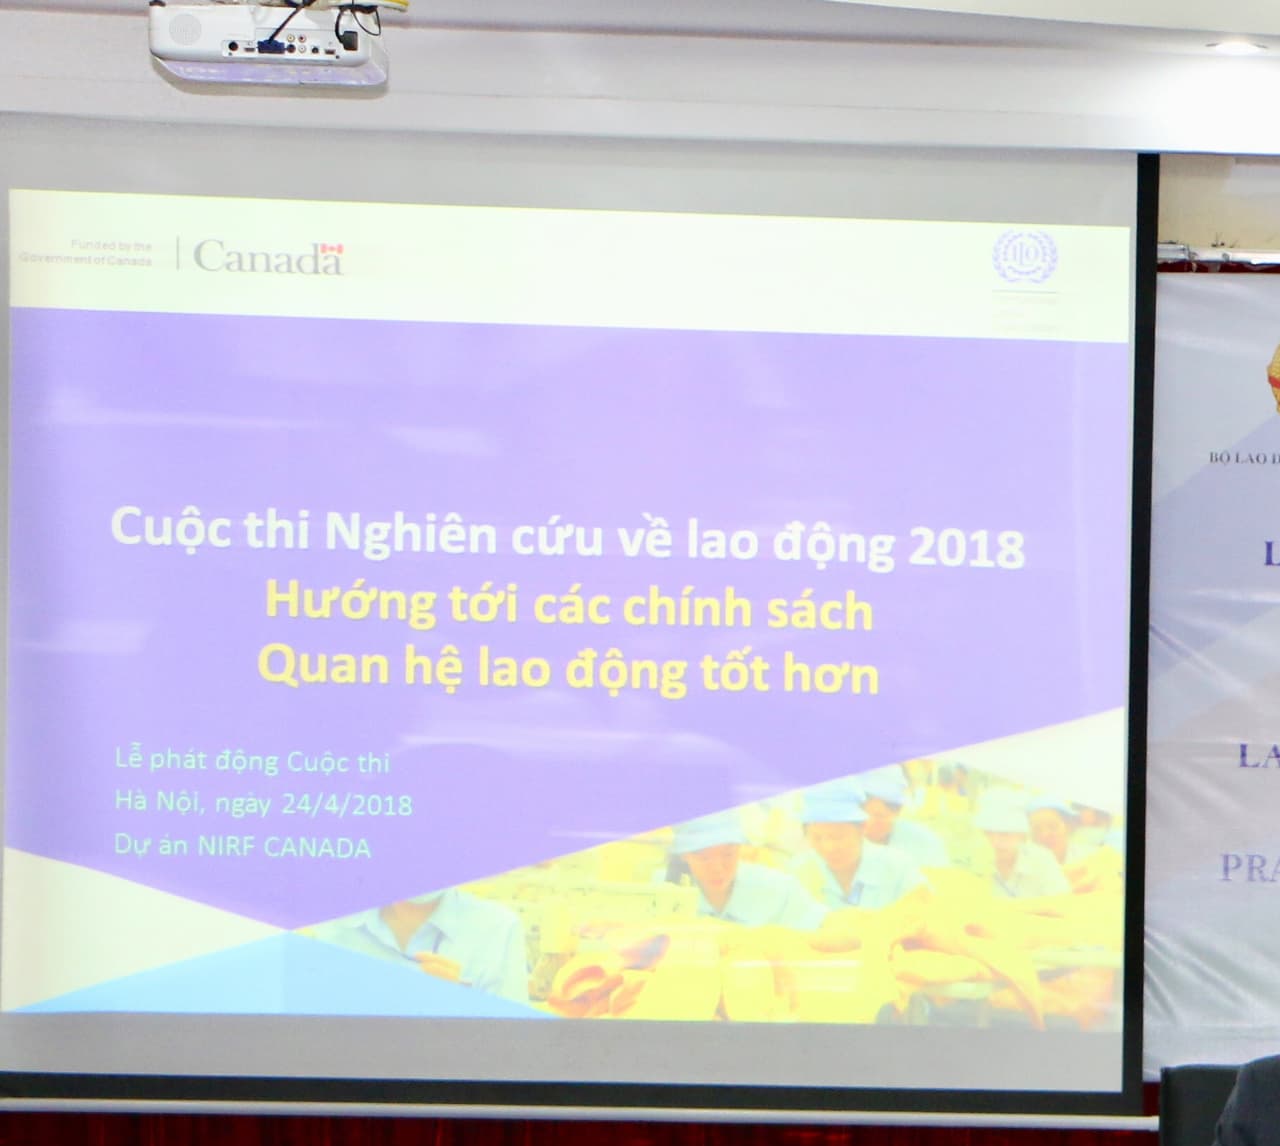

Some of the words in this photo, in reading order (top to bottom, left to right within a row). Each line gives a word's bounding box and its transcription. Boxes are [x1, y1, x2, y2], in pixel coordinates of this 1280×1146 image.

[193, 238, 345, 276] Canada
[111, 505, 232, 555] Cuộc
[244, 507, 310, 549] thi
[326, 511, 497, 561] Nghiên
[512, 515, 602, 556] cứu
[617, 512, 673, 558] về
[687, 517, 758, 560] lao
[773, 520, 896, 573] động
[908, 526, 1025, 569] 2018
[265, 577, 437, 631] Hướng
[448, 580, 517, 623] tới
[534, 583, 611, 625] các
[622, 585, 752, 627] chính
[767, 588, 873, 631] sách
[258, 642, 390, 688] Quan
[405, 644, 463, 694] hệ
[479, 645, 550, 687] lao
[566, 647, 687, 700] động
[700, 645, 769, 692] tốt
[783, 651, 879, 695] hơn
[115, 742, 143, 768] Lễ
[150, 748, 207, 772] phát
[215, 749, 278, 776] động
[287, 751, 350, 776] Cuộc
[358, 752, 391, 773] thi
[115, 789, 147, 811] Hà
[157, 791, 206, 816] Nội,
[215, 793, 271, 818] ngày
[282, 792, 413, 818] 24/4/2018
[115, 832, 151, 857] Dự
[159, 834, 188, 855] án
[199, 835, 255, 856] NIRF
[264, 836, 371, 858] CANADA
